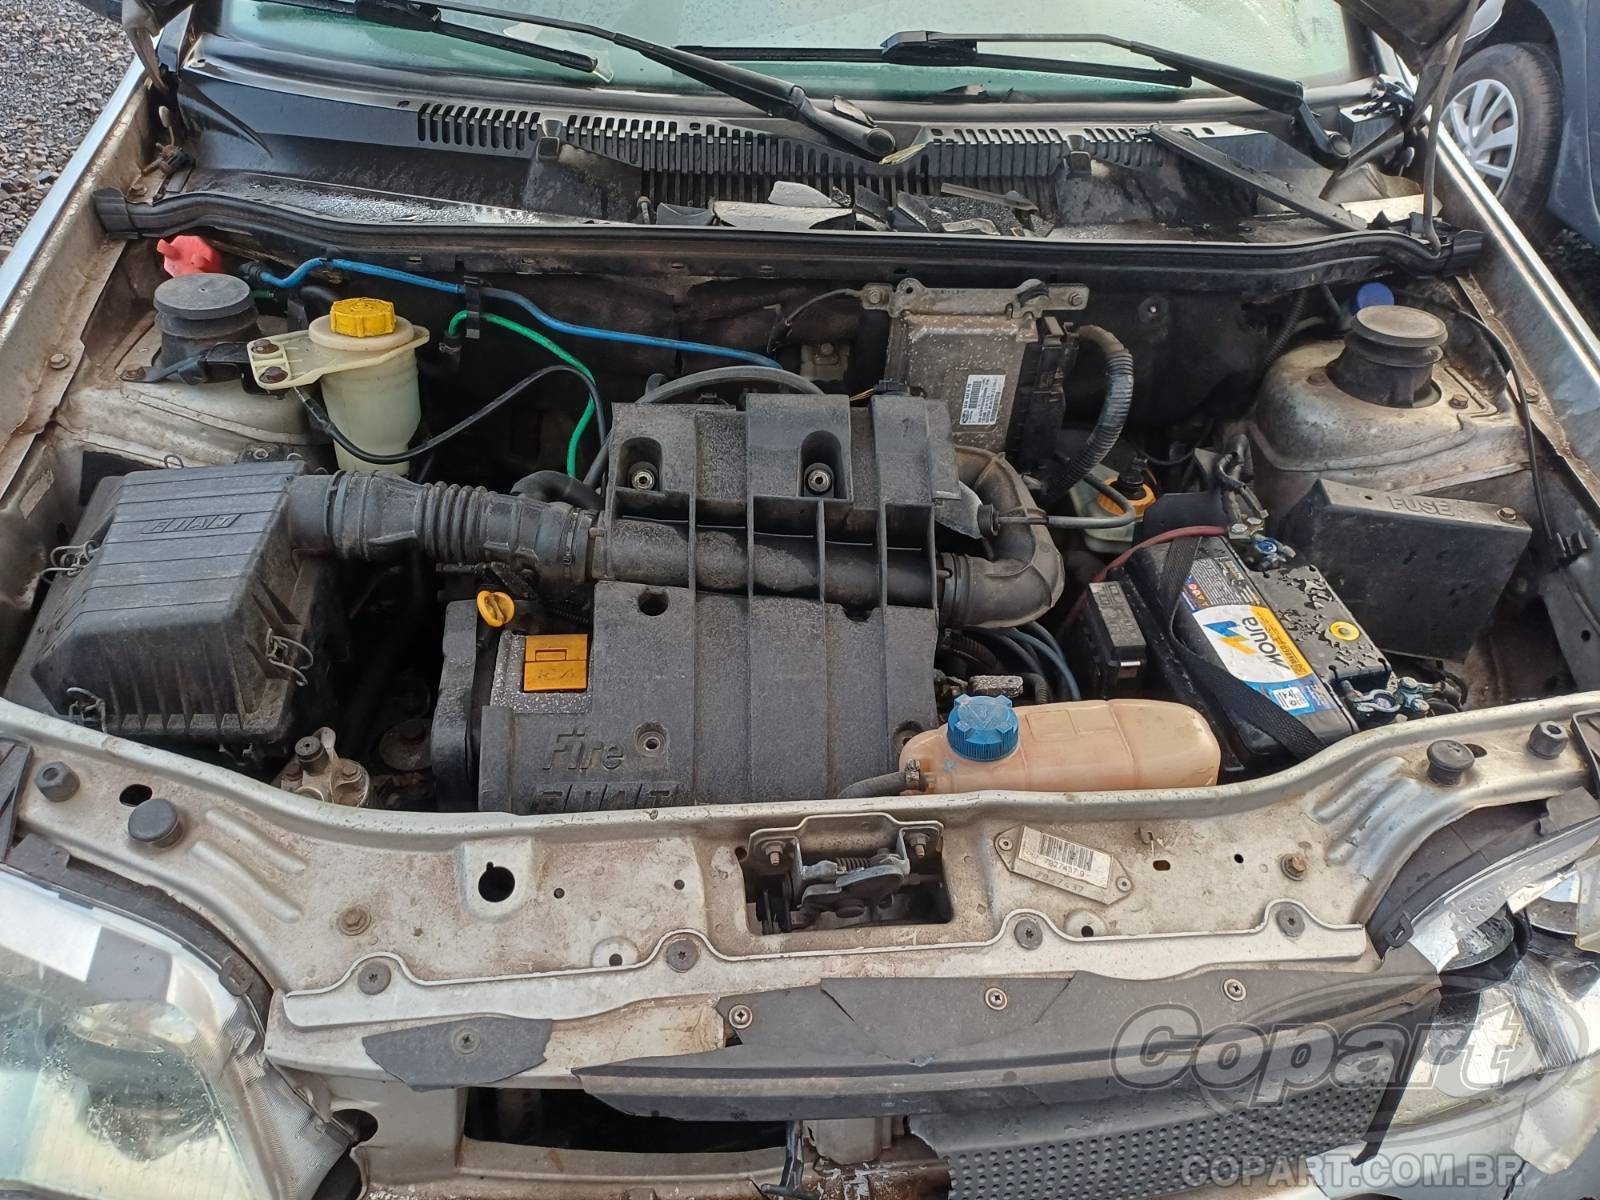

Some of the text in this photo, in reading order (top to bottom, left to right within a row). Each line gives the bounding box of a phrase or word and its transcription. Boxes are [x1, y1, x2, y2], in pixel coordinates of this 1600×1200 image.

[1387, 496, 1455, 516] FUSE
[145, 514, 239, 533] FIAT
[542, 724, 624, 770] Fire
